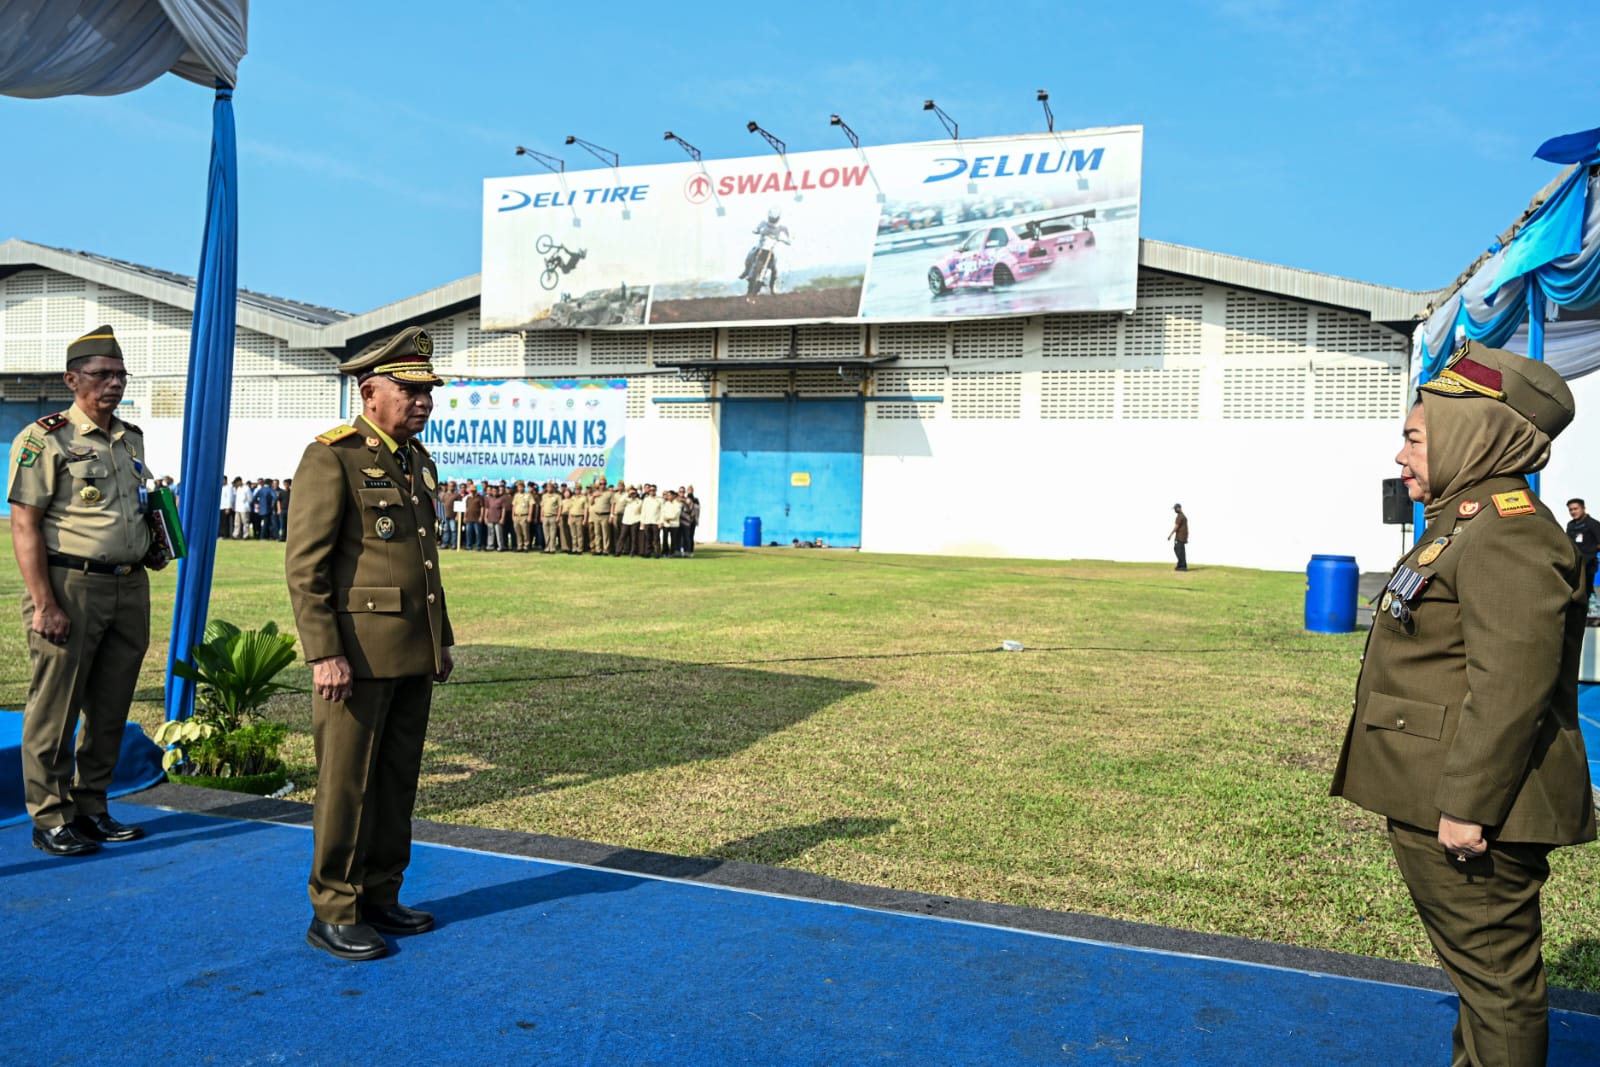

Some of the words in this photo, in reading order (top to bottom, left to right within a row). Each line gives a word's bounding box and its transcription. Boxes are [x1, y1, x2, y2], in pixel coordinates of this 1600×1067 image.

[922, 148, 1105, 183] DELIUM
[585, 184, 649, 204] TIRE
[717, 165, 870, 196] SWALLOW
[416, 419, 507, 444] INGATAN
[513, 420, 576, 445] BULAN
[583, 420, 607, 446] K3
[442, 452, 498, 465] SUMATERA
[501, 452, 536, 466] UTARA
[538, 453, 575, 467] TAHUN
[578, 454, 605, 467] 2026
